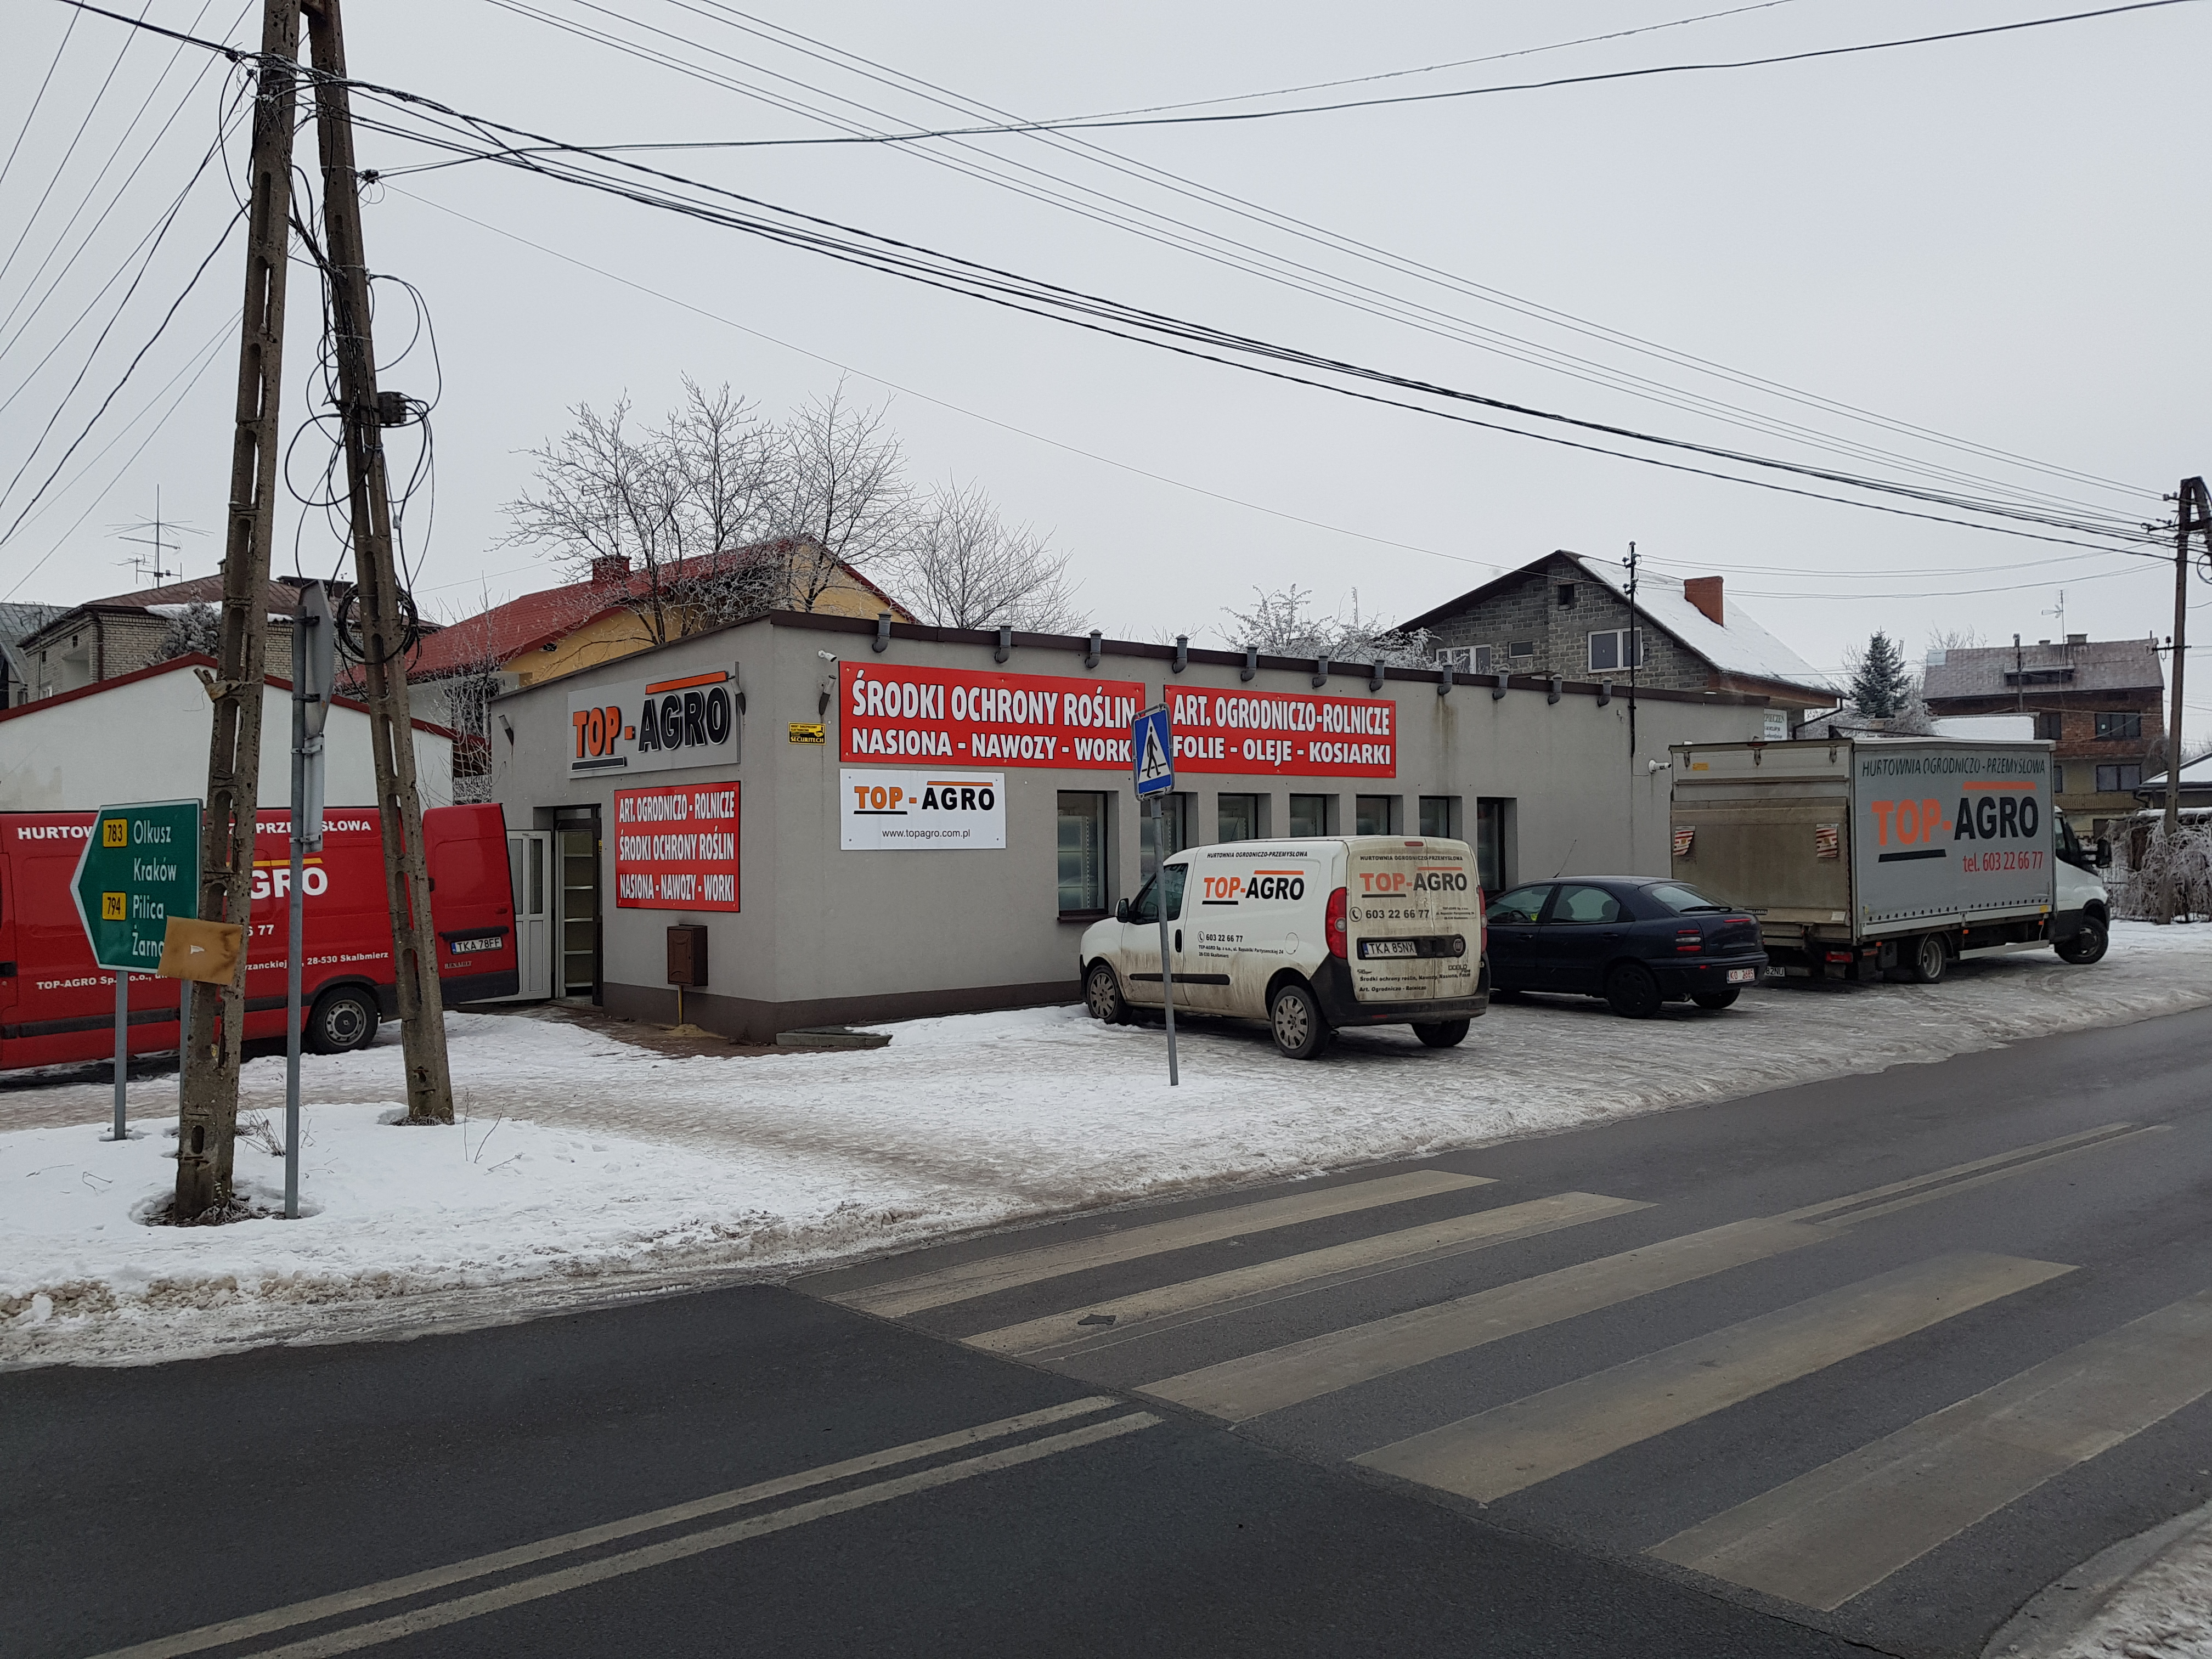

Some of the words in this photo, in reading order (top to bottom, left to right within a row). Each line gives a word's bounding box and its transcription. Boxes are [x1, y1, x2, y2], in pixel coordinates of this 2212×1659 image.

[851, 669, 944, 720] ŚRODKI
[951, 686, 1058, 725] OCHRONY
[1064, 686, 1135, 729] ROŚLIN
[1173, 694, 1211, 727] ART.
[1215, 696, 1390, 736] OGRODNICZO-ROLNICZE
[852, 727, 953, 757] NASIONA
[972, 733, 1057, 760] NAWOZY
[1074, 737, 1132, 762] WORK
[1173, 736, 1224, 759] FOLIE
[1243, 738, 1292, 766] OLEJE
[1309, 741, 1390, 765] KOSIARKI
[1863, 759, 1921, 776] HURTOWNIA
[1923, 757, 1980, 774] OGRODNICZO
[619, 798, 635, 823] ART.
[636, 794, 687, 822] OGRODNICZO
[695, 791, 735, 820] ROLNICZE
[108, 824, 123, 842] 783
[133, 820, 171, 843] Olkusz
[619, 829, 651, 861] ŚRODKI
[653, 834, 697, 861] OCHRONY
[699, 825, 734, 860] ROŚLIN
[882, 828, 970, 839] www.topagro.com.pl
[133, 857, 177, 881] Kraków
[1963, 853, 1980, 872] tel.
[1983, 853, 2001, 871] 603
[2004, 852, 2016, 870] 22
[2018, 852, 2030, 870] 66
[2032, 851, 2044, 870] 77
[620, 873, 654, 899] NASIONA
[661, 873, 696, 900] NAWOZY
[703, 874, 734, 901] WORKI
[107, 897, 121, 915] 794
[133, 895, 164, 919] Pilica
[1365, 910, 1385, 919] 603
[1389, 910, 1400, 918] 22
[1404, 910, 1415, 918] 66
[1418, 910, 1430, 918] 77
[258, 924, 274, 935] 77
[457, 941, 476, 951] TKA
[479, 938, 499, 949] 78FF
[1369, 943, 1390, 954] TKA
[1392, 943, 1414, 953] 85NX
[307, 956, 337, 965] 28-530
[340, 952, 388, 962] Skalbmierz
[36, 977, 97, 990] TOP-AGRO
[100, 977, 117, 986] Sp.
